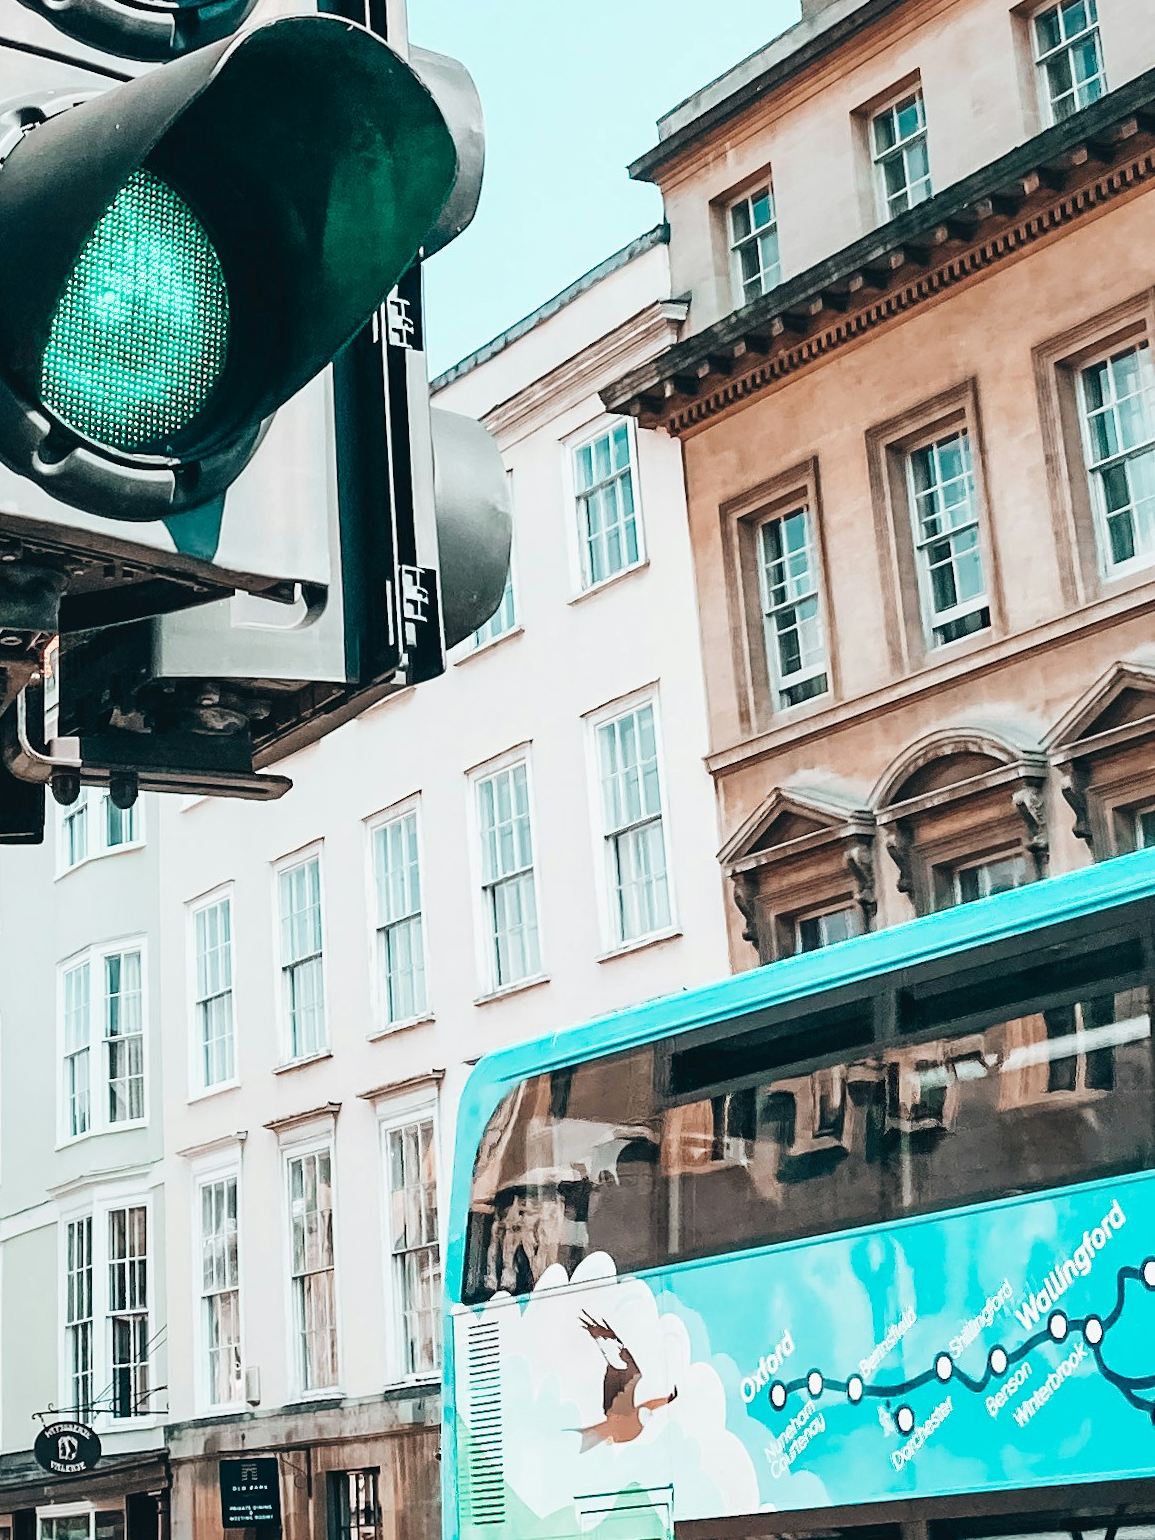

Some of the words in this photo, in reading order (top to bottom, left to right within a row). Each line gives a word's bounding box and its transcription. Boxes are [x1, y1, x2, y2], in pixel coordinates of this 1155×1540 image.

[1014, 1199, 1126, 1331] Wallingford
[948, 1278, 1013, 1359] Shillingford
[740, 1329, 795, 1403] Oxford
[984, 1361, 1033, 1417] Benson
[1012, 1341, 1088, 1428] Winterbrook
[764, 1400, 816, 1463] Nuneham
[891, 1395, 954, 1472] Dorchester
